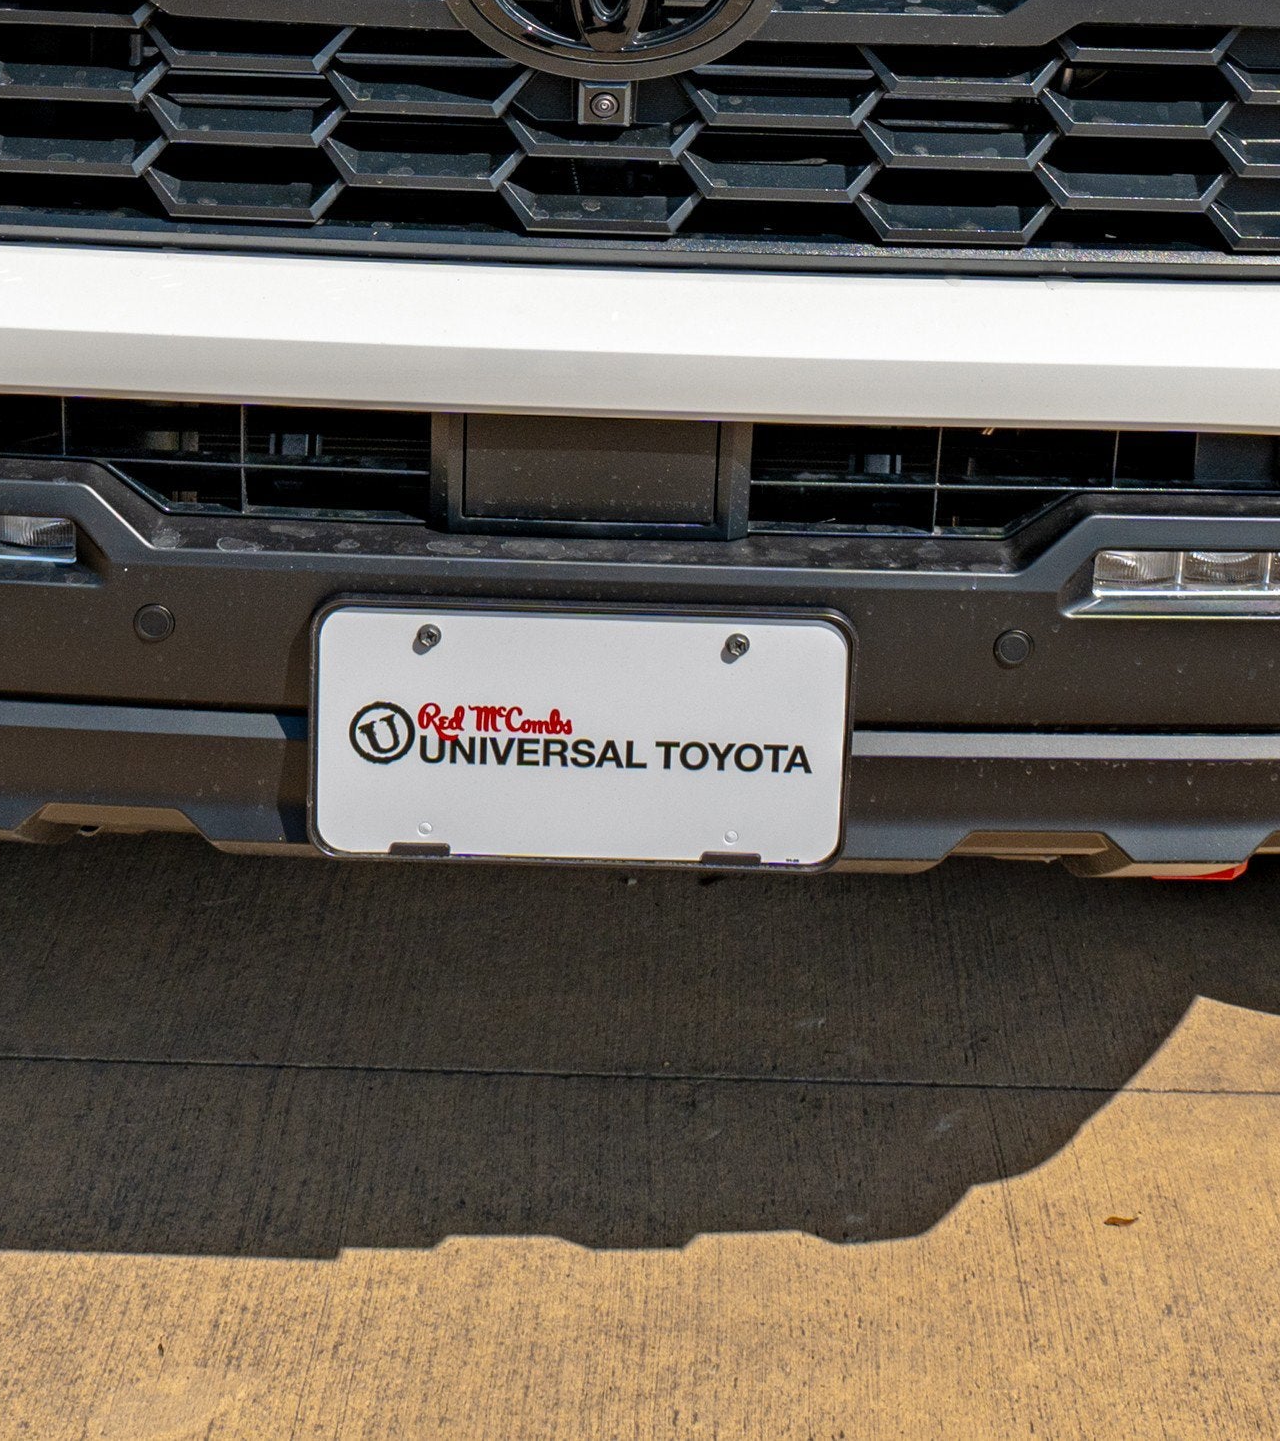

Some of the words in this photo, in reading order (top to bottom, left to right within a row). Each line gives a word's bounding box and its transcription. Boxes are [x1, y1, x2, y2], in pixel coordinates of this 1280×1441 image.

[417, 702, 466, 742] Red
[468, 704, 574, 736] McCombs
[419, 736, 648, 769] UNIVERSAL
[655, 741, 813, 774] TOYOTA
